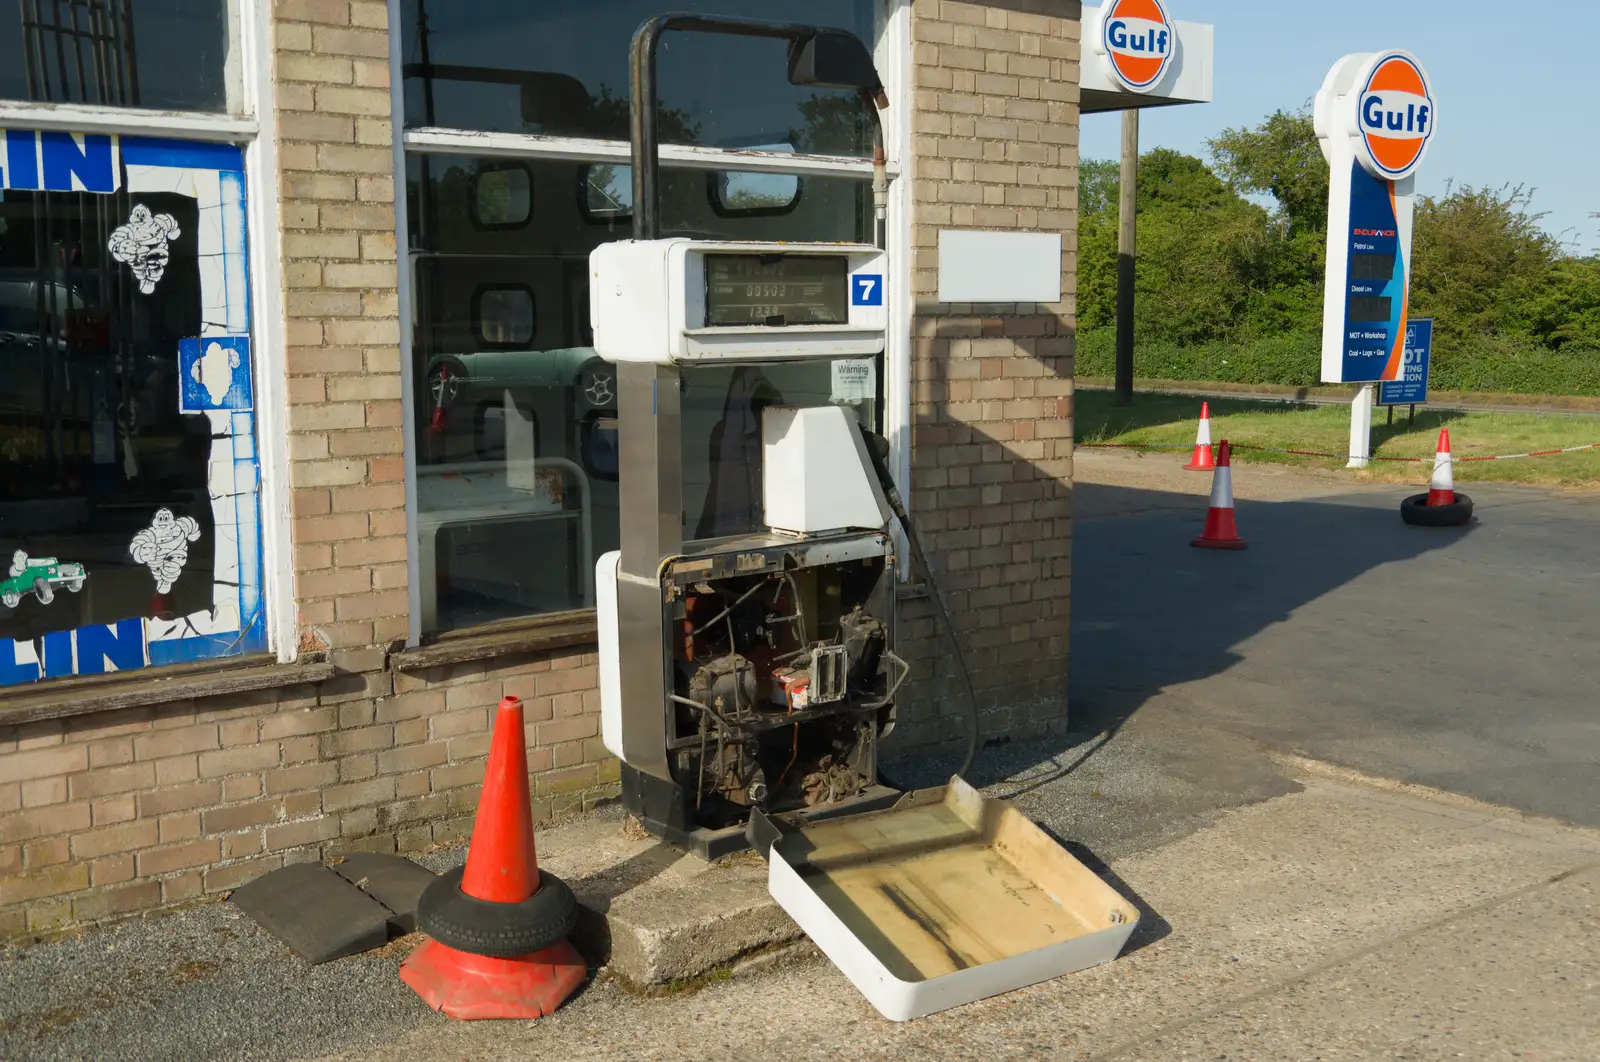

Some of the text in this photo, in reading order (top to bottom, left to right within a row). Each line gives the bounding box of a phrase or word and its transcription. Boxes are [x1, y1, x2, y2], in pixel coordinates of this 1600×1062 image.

[1108, 21, 1168, 54] Gulf
[1363, 95, 1429, 133] Gulf
[0, 129, 119, 193] IN
[1353, 228, 1395, 237] ENDURANCE
[1353, 242, 1366, 250] Petrol
[858, 280, 876, 301] 7
[1351, 285, 1364, 293] Diesel
[1349, 331, 1387, 340] MOT Workshop
[1404, 348, 1425, 364] OT
[837, 364, 869, 376] Warning
[1403, 364, 1423, 373] TING
[1403, 373, 1423, 381] TION
